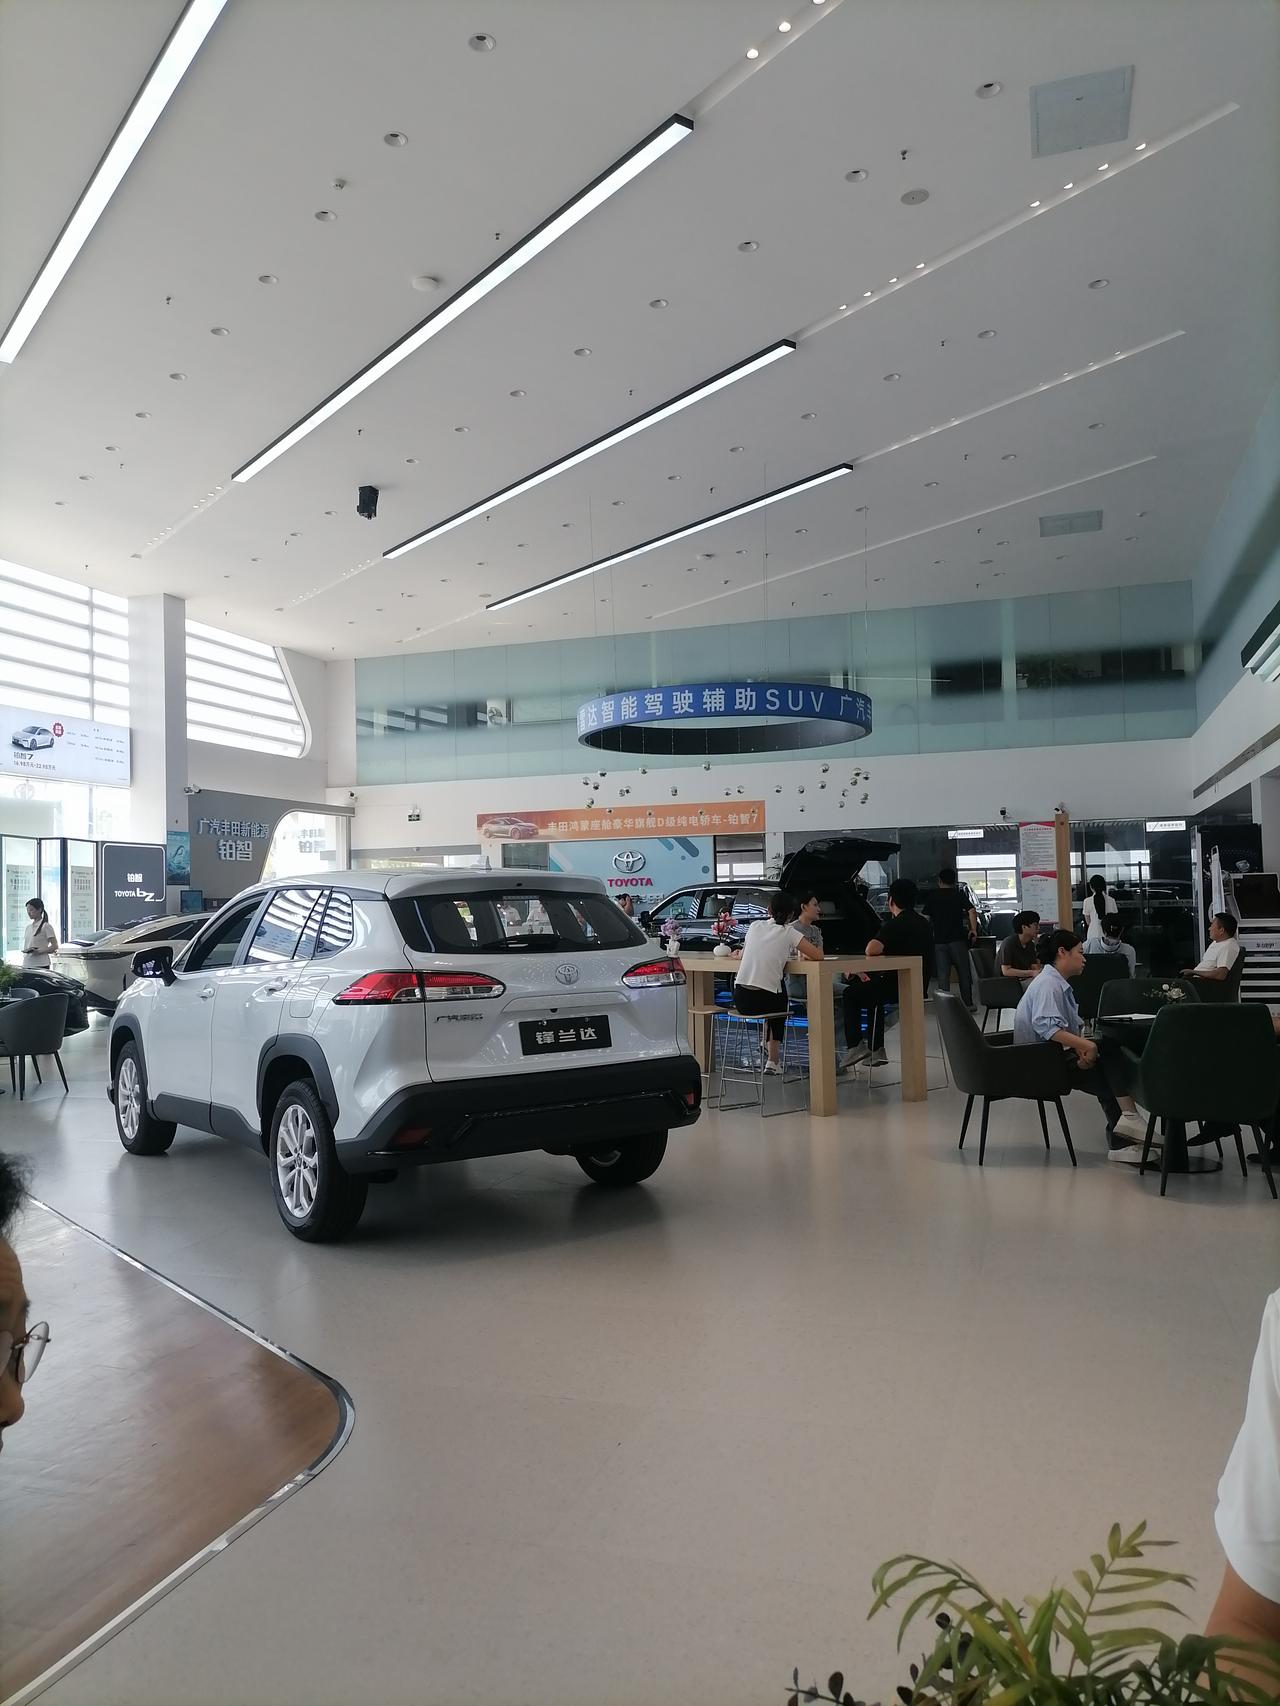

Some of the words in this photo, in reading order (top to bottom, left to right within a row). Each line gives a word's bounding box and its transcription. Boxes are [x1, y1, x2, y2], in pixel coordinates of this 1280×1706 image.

[198, 818, 270, 839] 广汽丰田新能源
[218, 839, 253, 861] 铂智
[607, 877, 653, 887] TOYOTA
[114, 890, 135, 898] TOYOTA
[536, 1028, 598, 1044] 锋兰达
